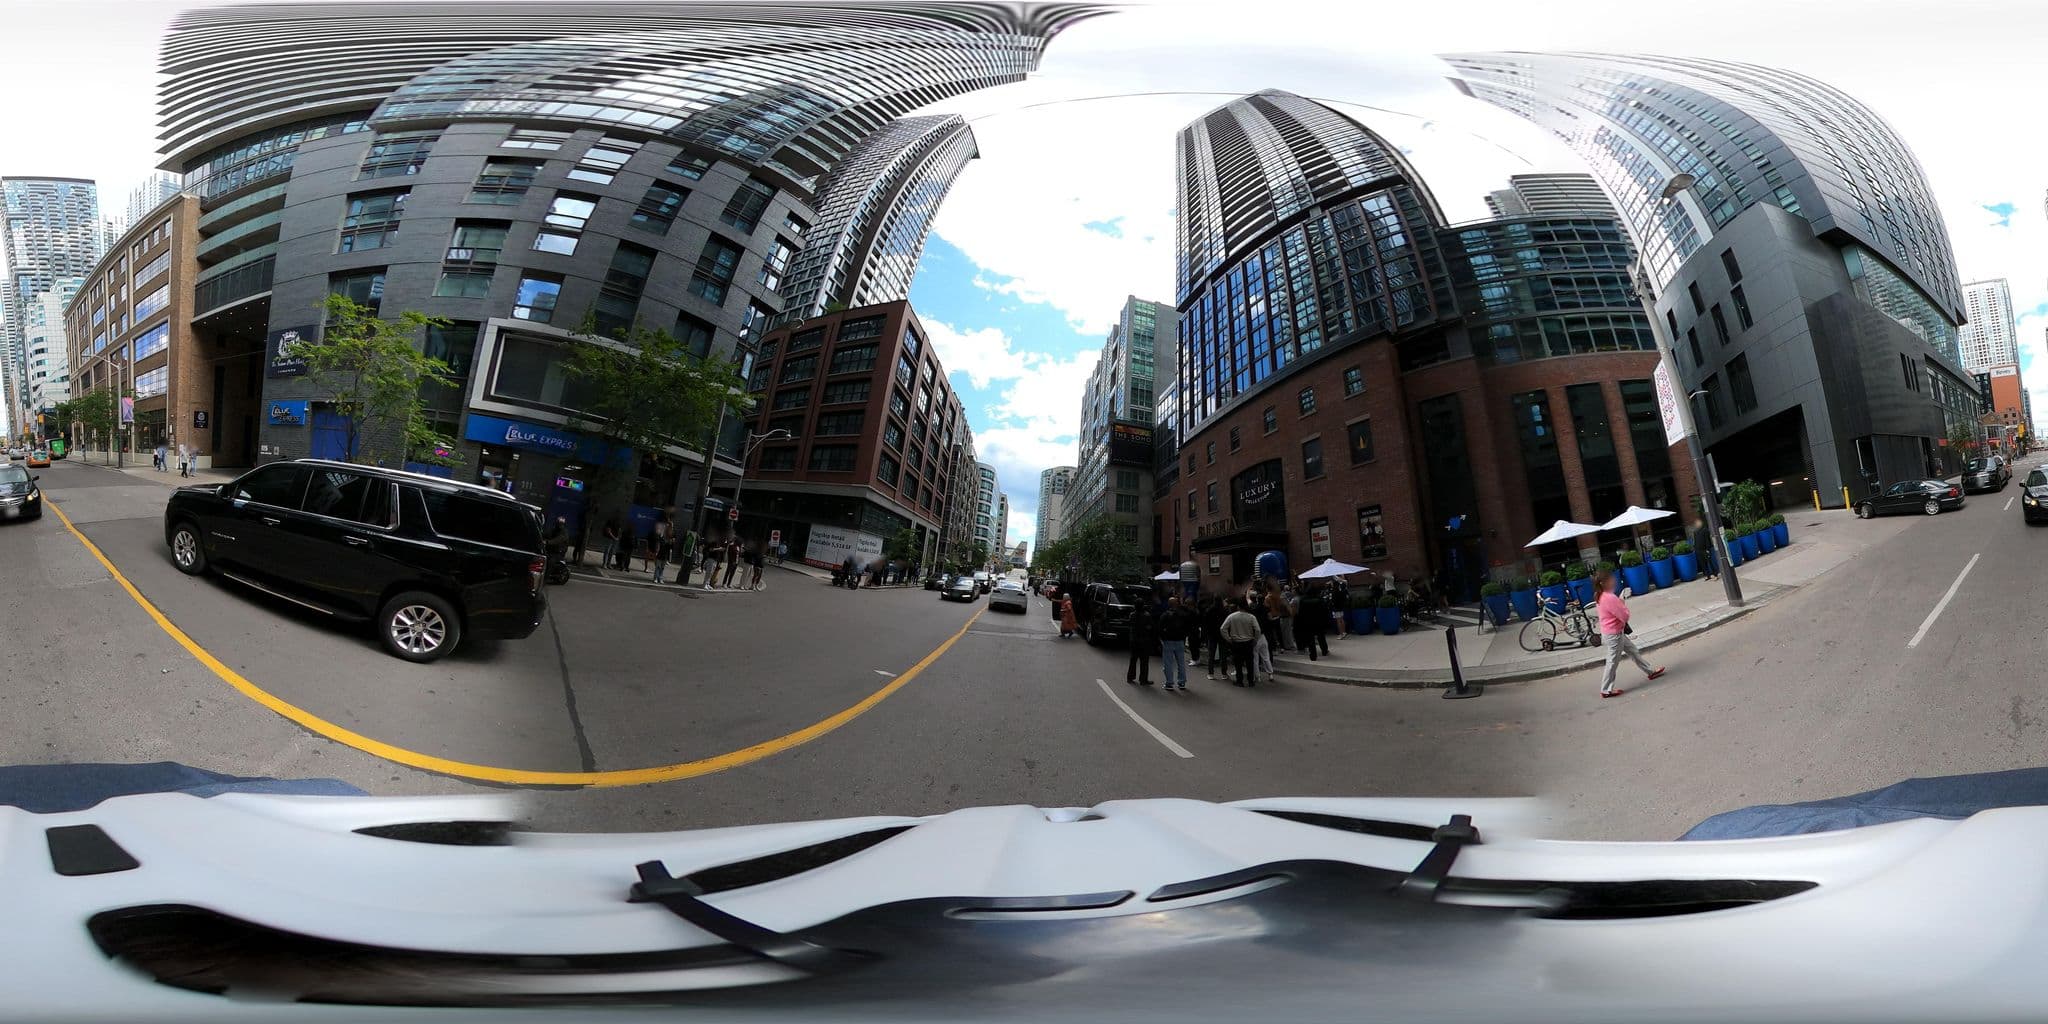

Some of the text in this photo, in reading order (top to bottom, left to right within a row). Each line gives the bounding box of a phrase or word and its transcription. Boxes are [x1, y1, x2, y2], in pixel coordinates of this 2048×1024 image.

[510, 428, 578, 449] BLUE EXPRESS
[1130, 434, 1152, 443] SOHO
[1240, 480, 1277, 500] LUXURY
